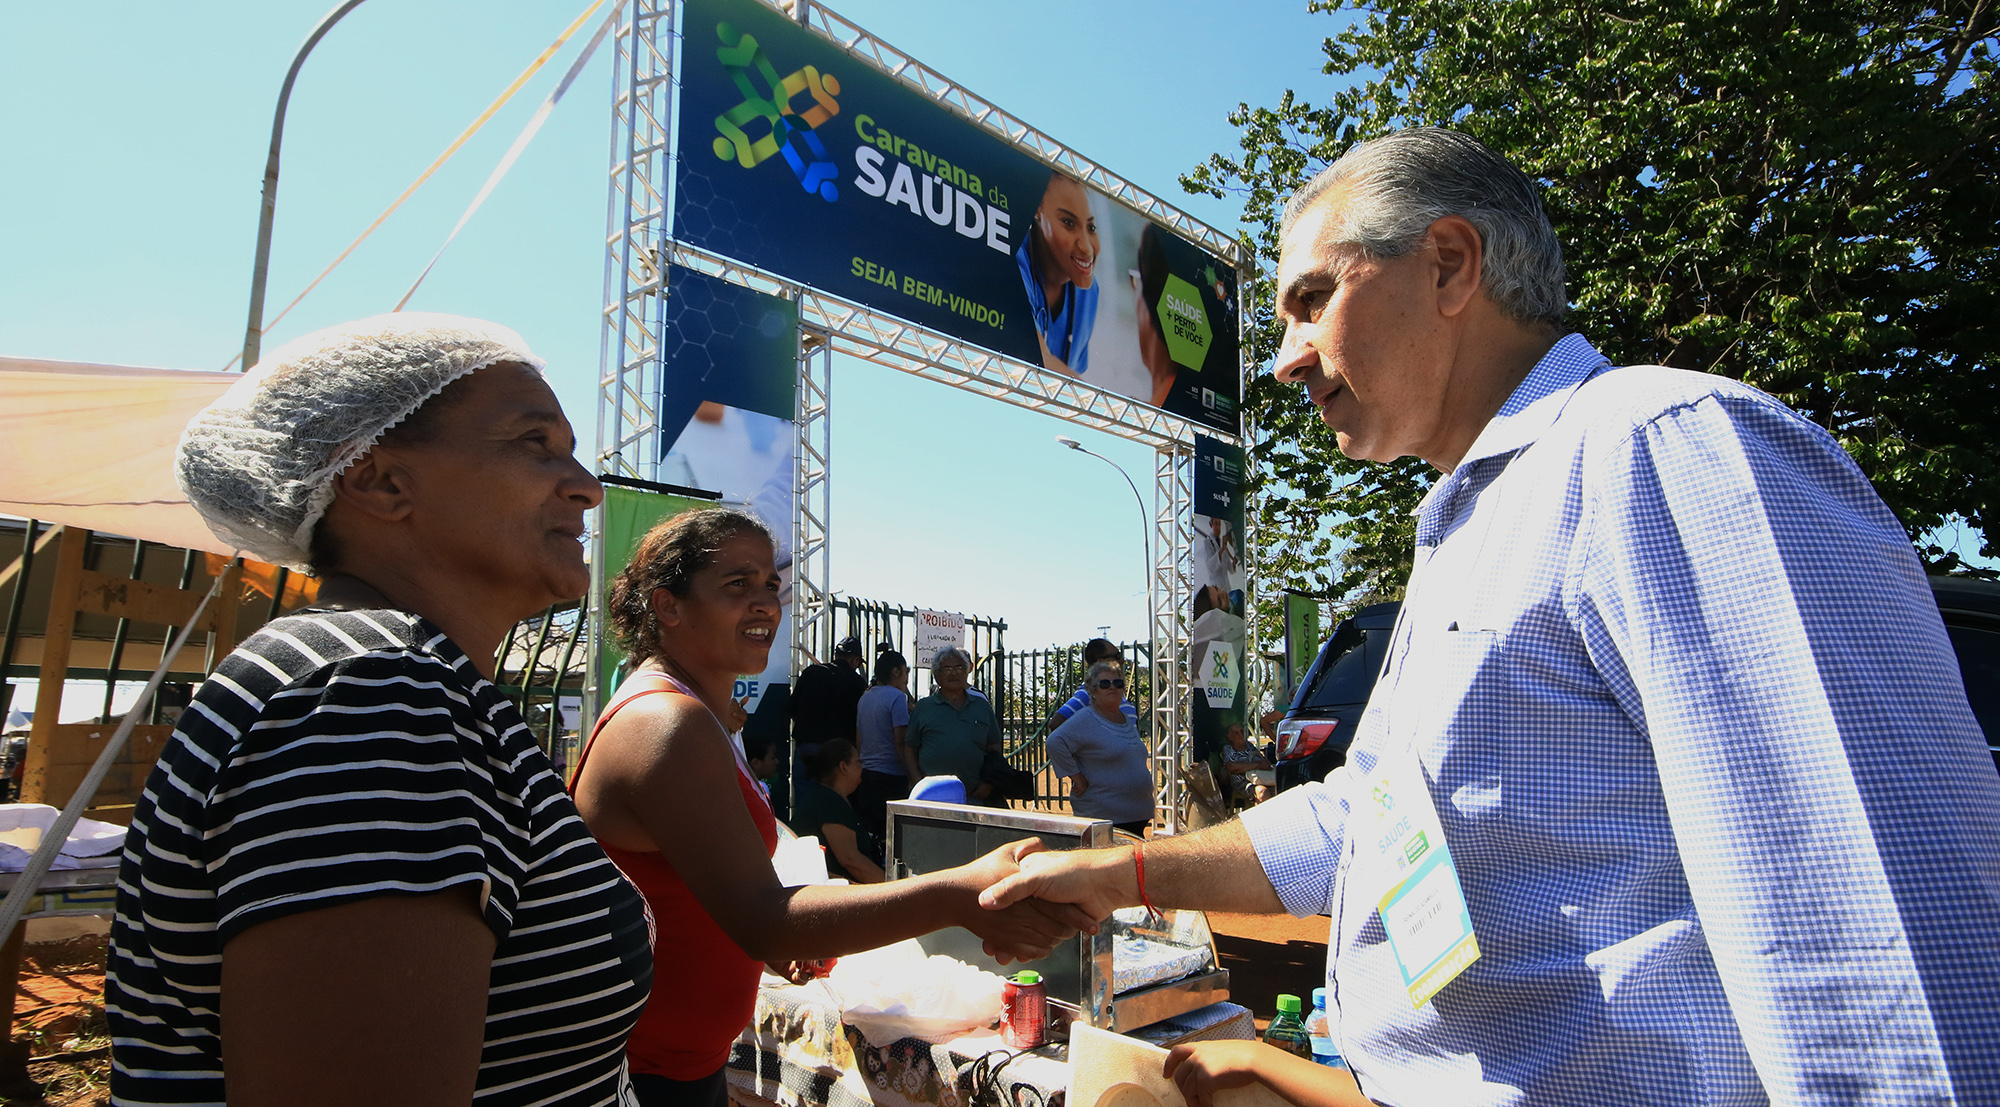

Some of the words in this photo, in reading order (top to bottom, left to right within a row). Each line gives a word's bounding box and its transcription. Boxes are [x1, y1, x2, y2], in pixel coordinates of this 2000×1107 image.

[854, 113, 984, 198] Caravana
[988, 185, 1009, 210] da
[853, 145, 1011, 256] SAÚDE
[850, 256, 898, 291] SEJA
[902, 275, 1005, 331] BEM-VINDO!
[1166, 293, 1203, 325] SAÚDE
[1174, 313, 1197, 332] PERTO
[1174, 325, 1184, 338] DE
[1185, 329, 1204, 347] VOCÊ
[920, 613, 963, 629] PROIBIDO
[1207, 686, 1233, 699] SAÚDE
